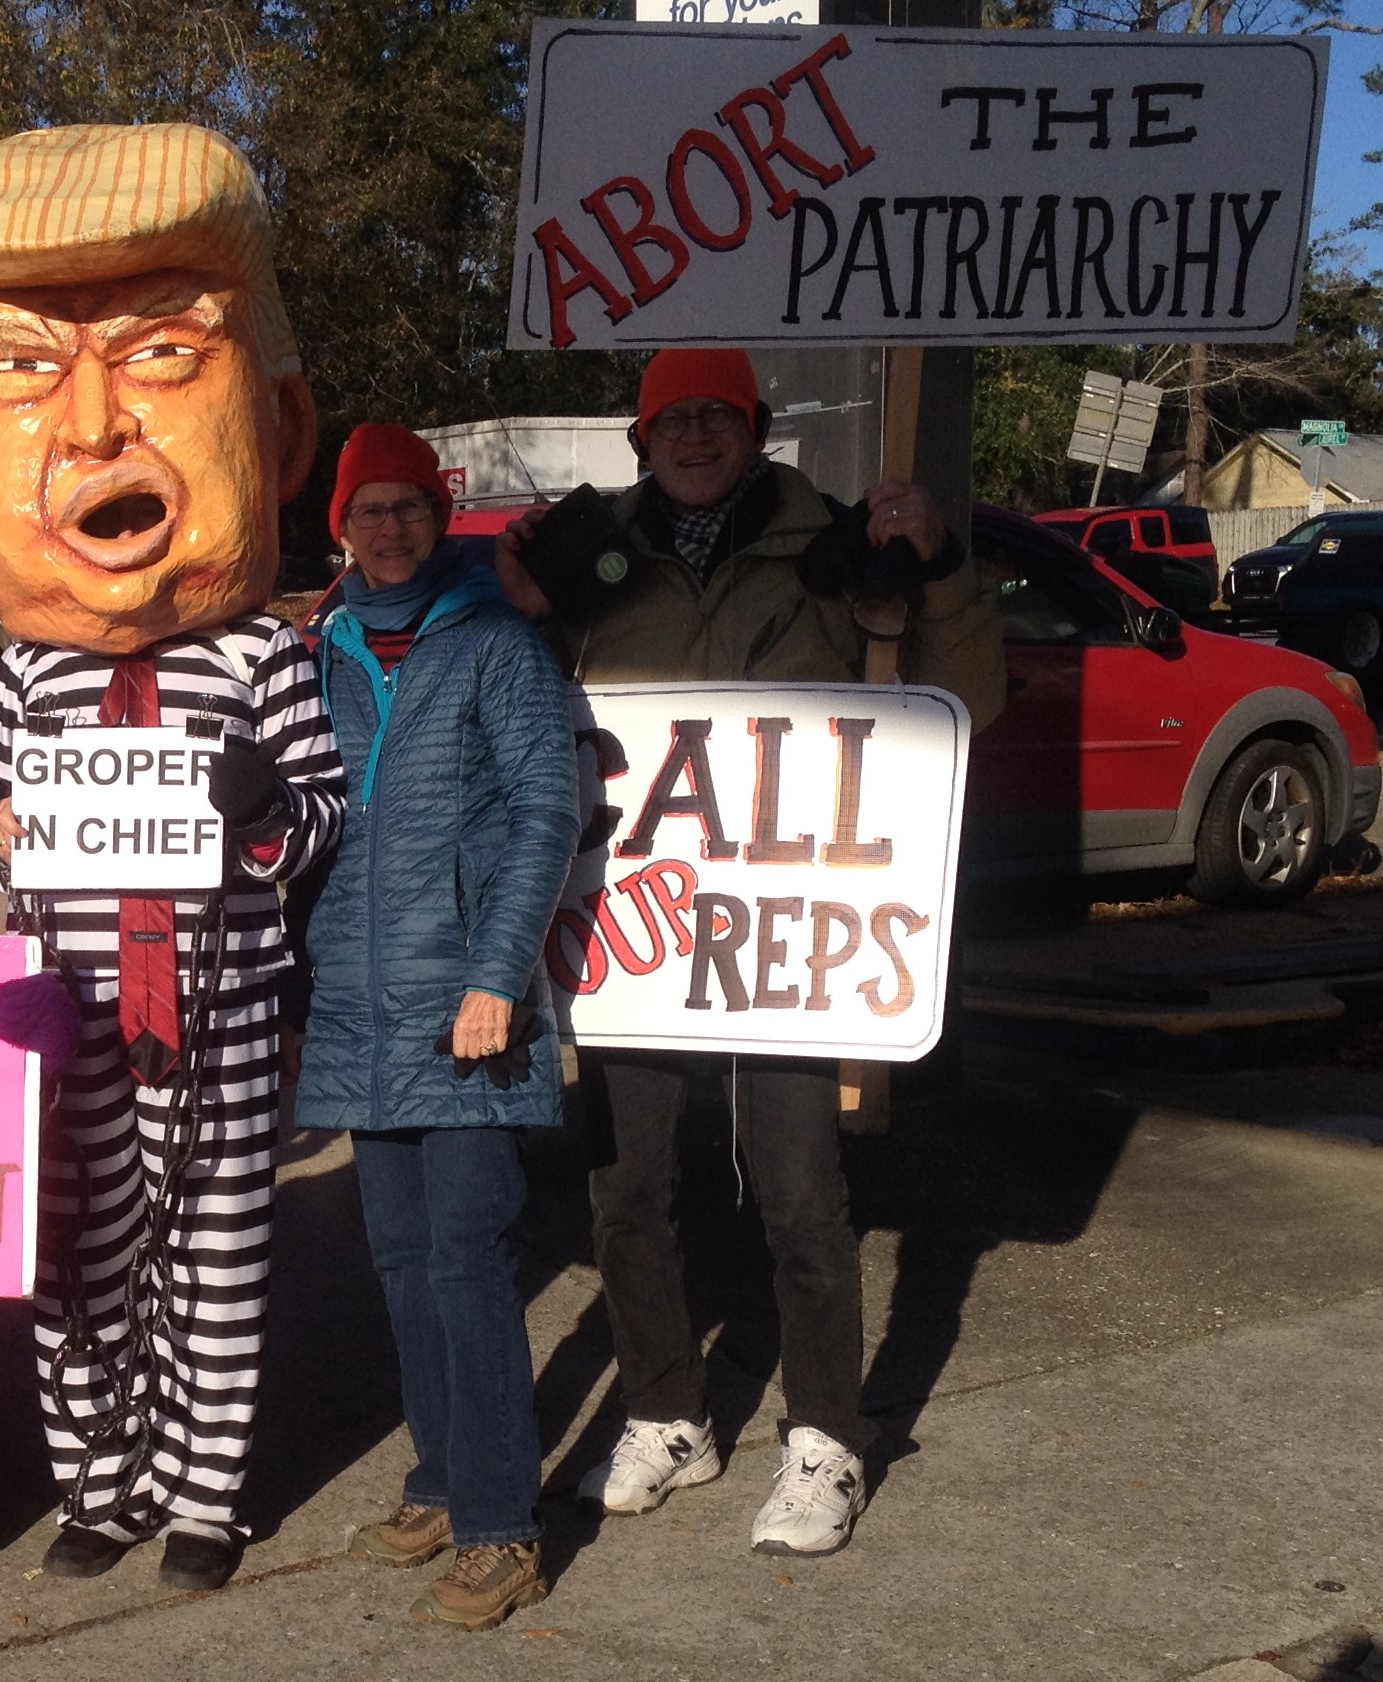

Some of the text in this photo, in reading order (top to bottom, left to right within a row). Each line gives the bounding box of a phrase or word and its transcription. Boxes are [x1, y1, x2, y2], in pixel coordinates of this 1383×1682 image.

[531, 33, 1205, 349] ABORT THE
[781, 190, 1282, 324] PATRIARCHY
[15, 748, 214, 786] GROPER
[76, 817, 218, 855] CHIEF
[684, 892, 931, 1018] REPS
